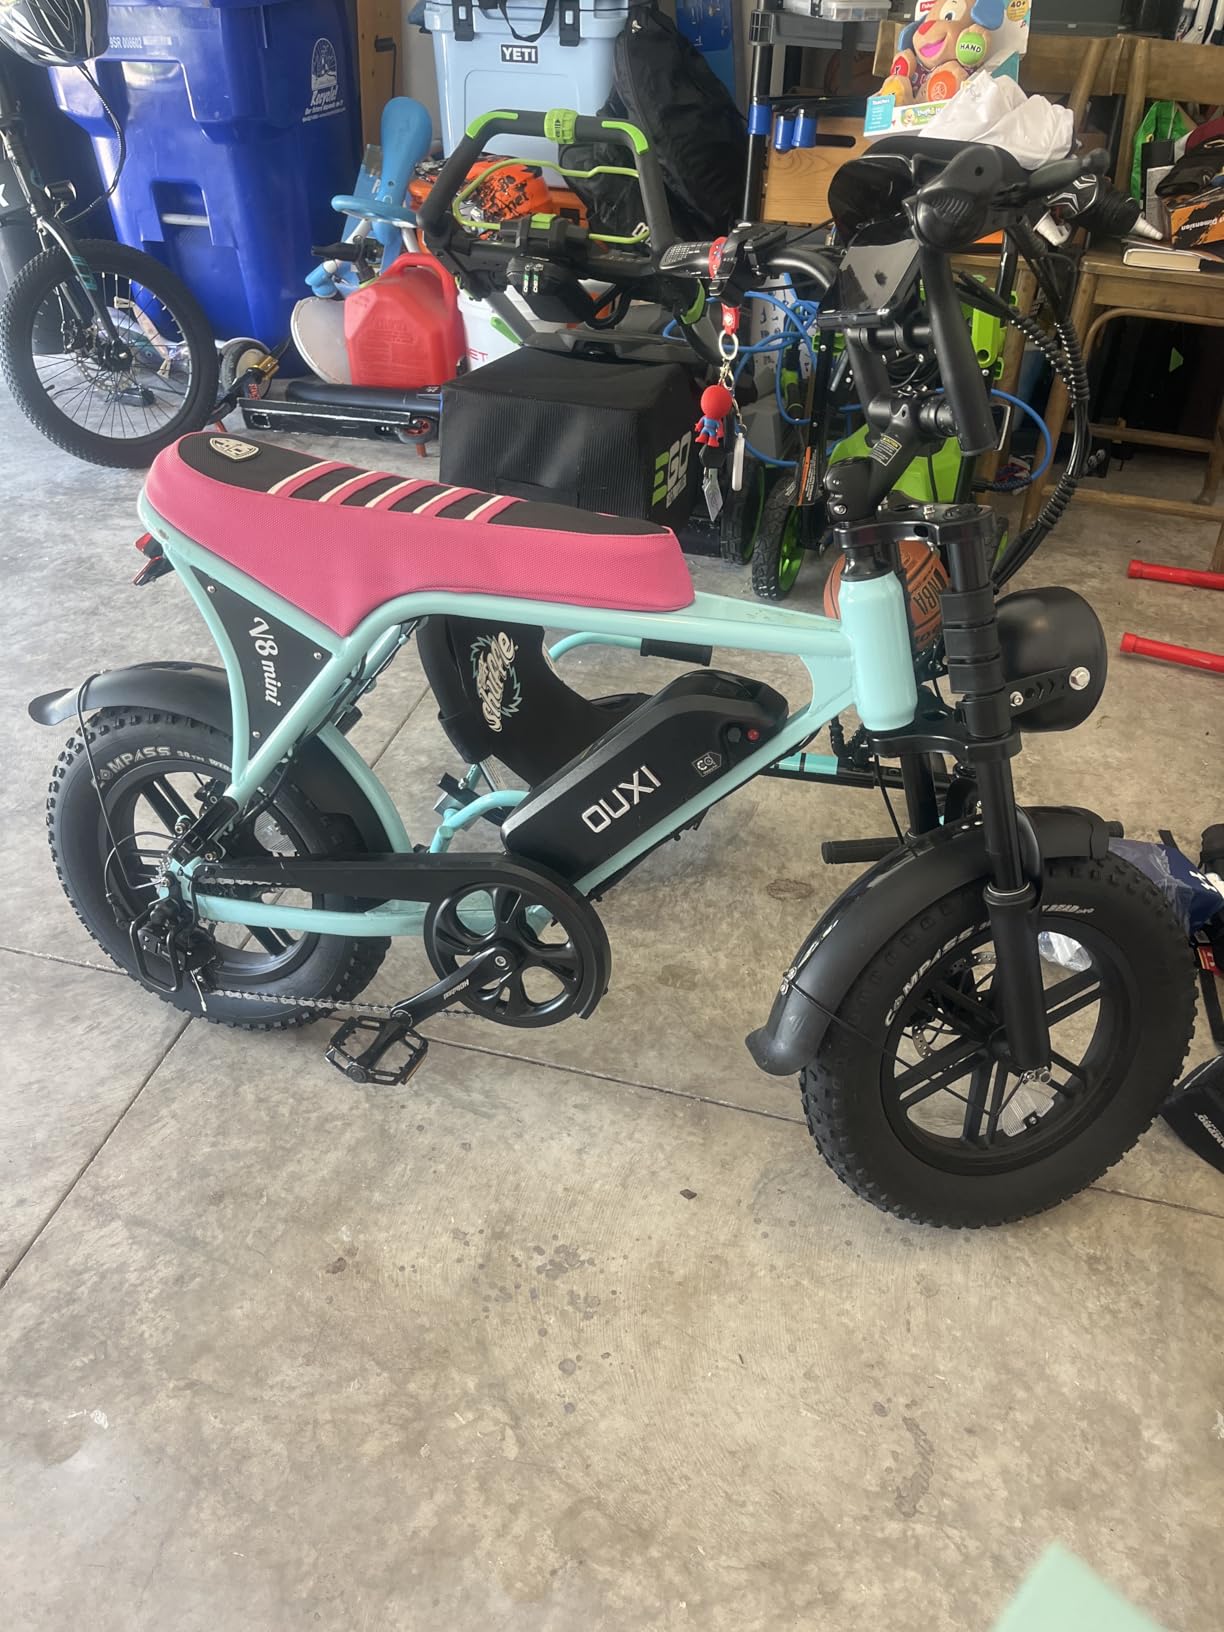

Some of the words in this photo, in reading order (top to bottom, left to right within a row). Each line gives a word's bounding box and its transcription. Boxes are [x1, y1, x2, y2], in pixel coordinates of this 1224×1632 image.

[502, 46, 536, 62] YETI
[960, 43, 982, 54] HAND
[652, 430, 692, 507] EGO
[248, 616, 279, 657] V8
[260, 659, 282, 707] mini
[581, 764, 662, 834] OUXI
[884, 924, 975, 1027] COMPASS
